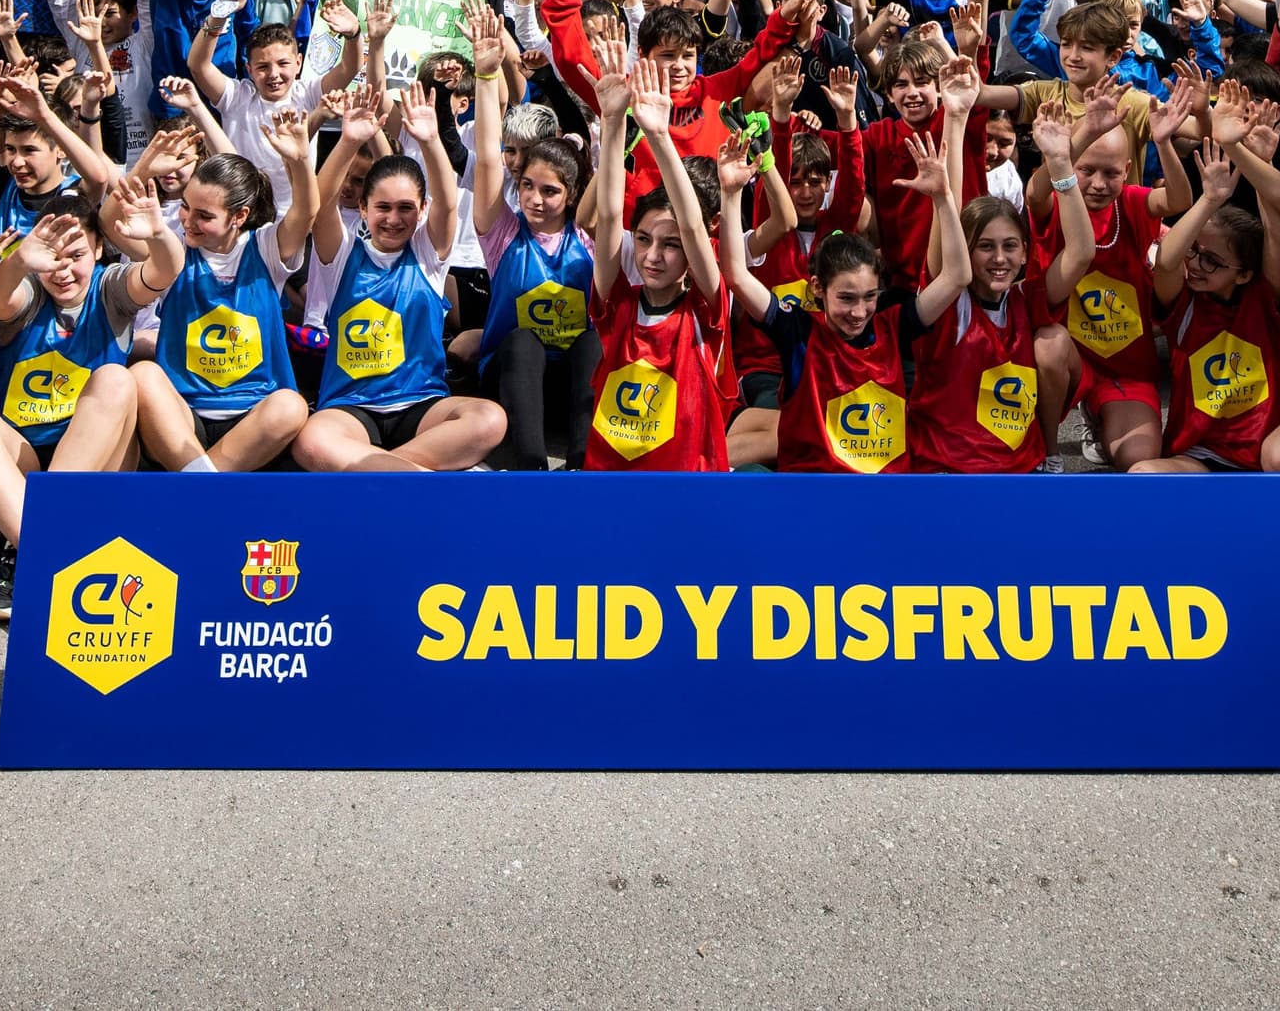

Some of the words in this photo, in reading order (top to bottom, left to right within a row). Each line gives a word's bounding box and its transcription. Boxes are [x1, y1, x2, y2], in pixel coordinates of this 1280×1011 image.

[1080, 321, 1129, 333] CRUYFF
[198, 351, 251, 366] CRUYFF
[346, 349, 393, 361] CRUYFF
[1206, 384, 1256, 401] CRUYFF
[18, 401, 73, 413] CRUYFF
[608, 415, 661, 432] CRUYFF
[839, 437, 893, 450] CRUYFF
[259, 566, 282, 575] FCB
[416, 583, 664, 661] SALID
[683, 585, 738, 660] Y
[752, 583, 1229, 661] DISFRUTAD
[199, 614, 333, 647] FUNDACIÓ
[67, 631, 153, 648] CRUYFF
[71, 654, 147, 663] FOUNDATION
[220, 653, 308, 683] BARÇA
